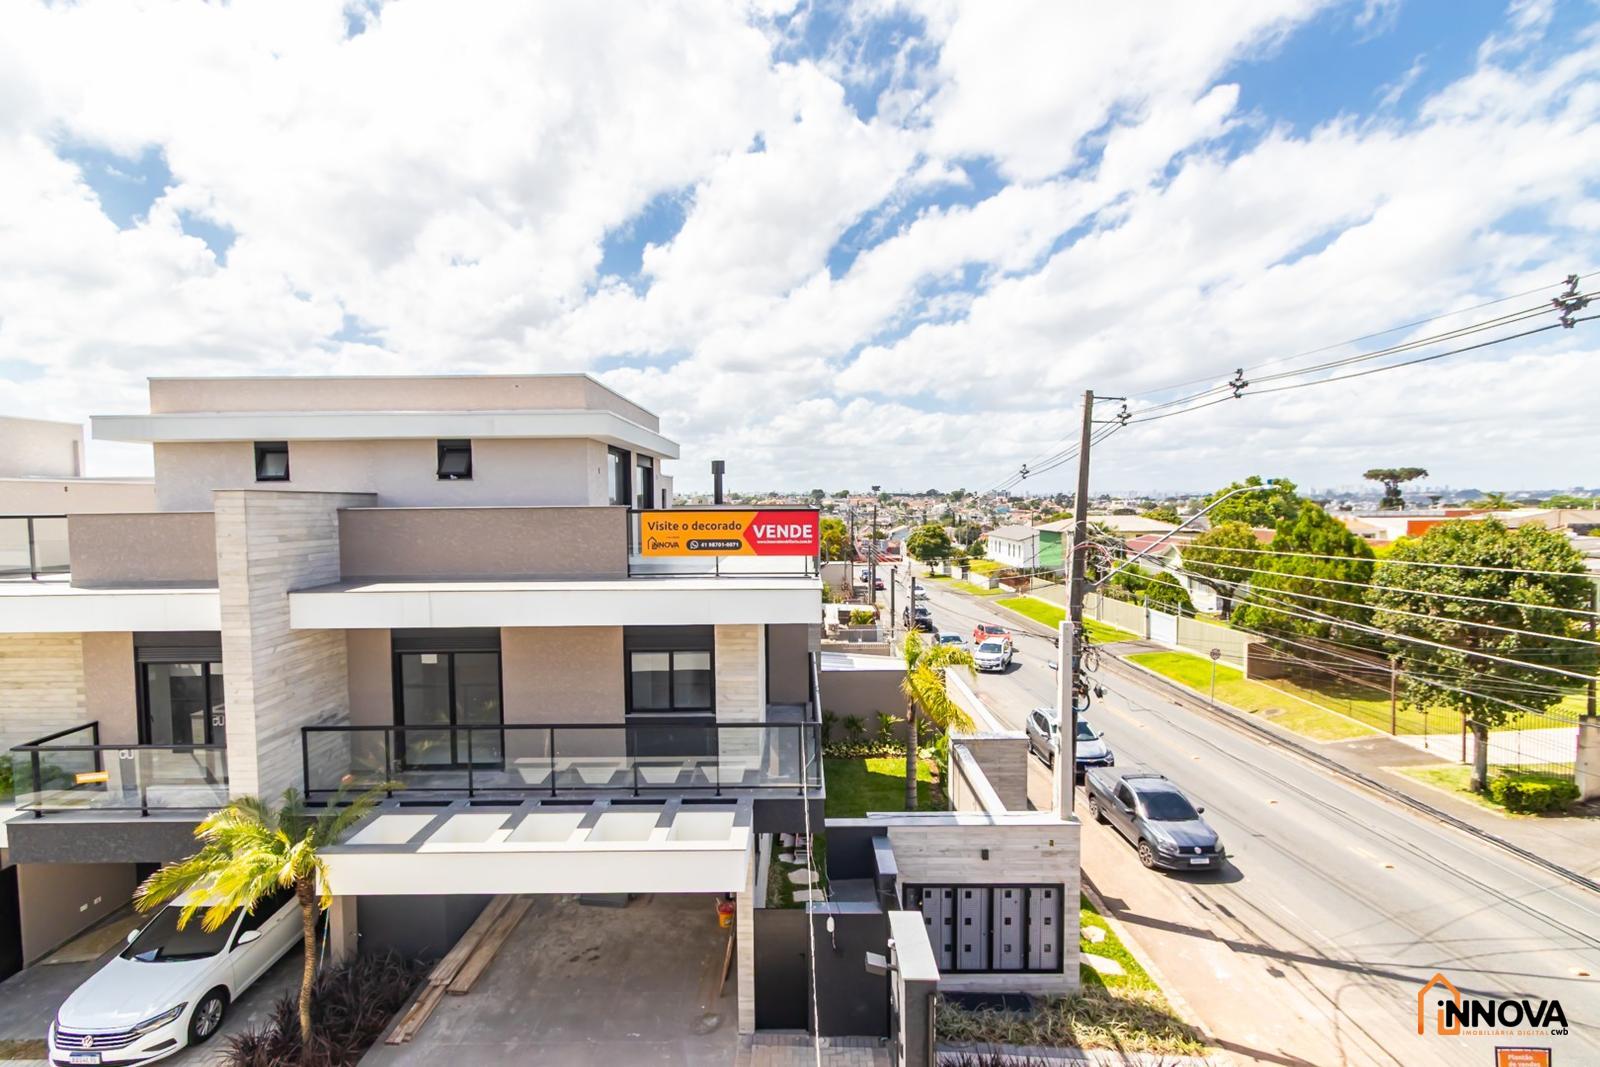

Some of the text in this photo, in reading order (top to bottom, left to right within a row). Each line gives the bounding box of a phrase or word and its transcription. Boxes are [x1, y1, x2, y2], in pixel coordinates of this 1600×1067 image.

[647, 521, 742, 531] Visite o decorado
[752, 524, 813, 538] VENDE
